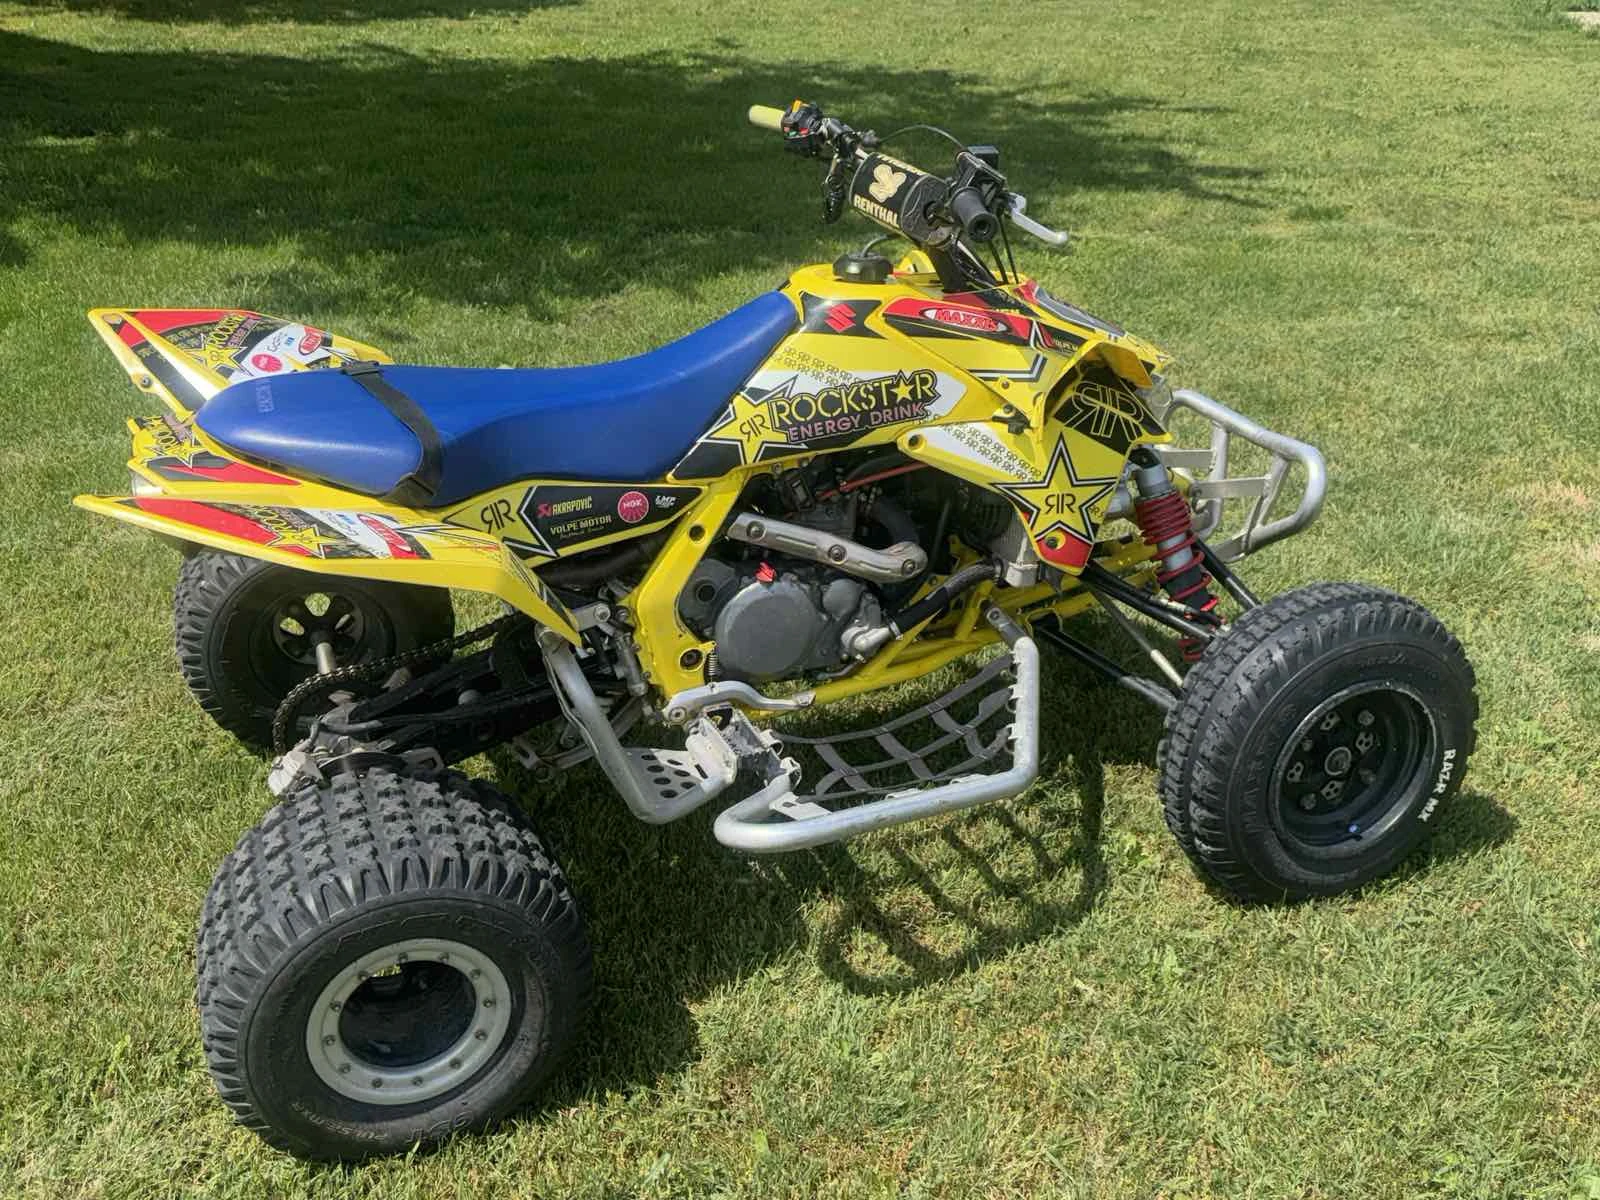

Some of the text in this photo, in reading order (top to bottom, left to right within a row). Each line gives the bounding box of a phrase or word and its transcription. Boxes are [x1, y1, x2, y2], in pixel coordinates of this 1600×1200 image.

[853, 193, 901, 229] RENTHAL
[935, 308, 999, 333] MAXXIS
[772, 371, 937, 427] ROCKSTAR
[789, 402, 926, 442] ENERGY DRINK
[550, 522, 578, 536] VOLPE
[579, 514, 613, 529] MOTOR
[1417, 748, 1456, 822] RAZR MX
